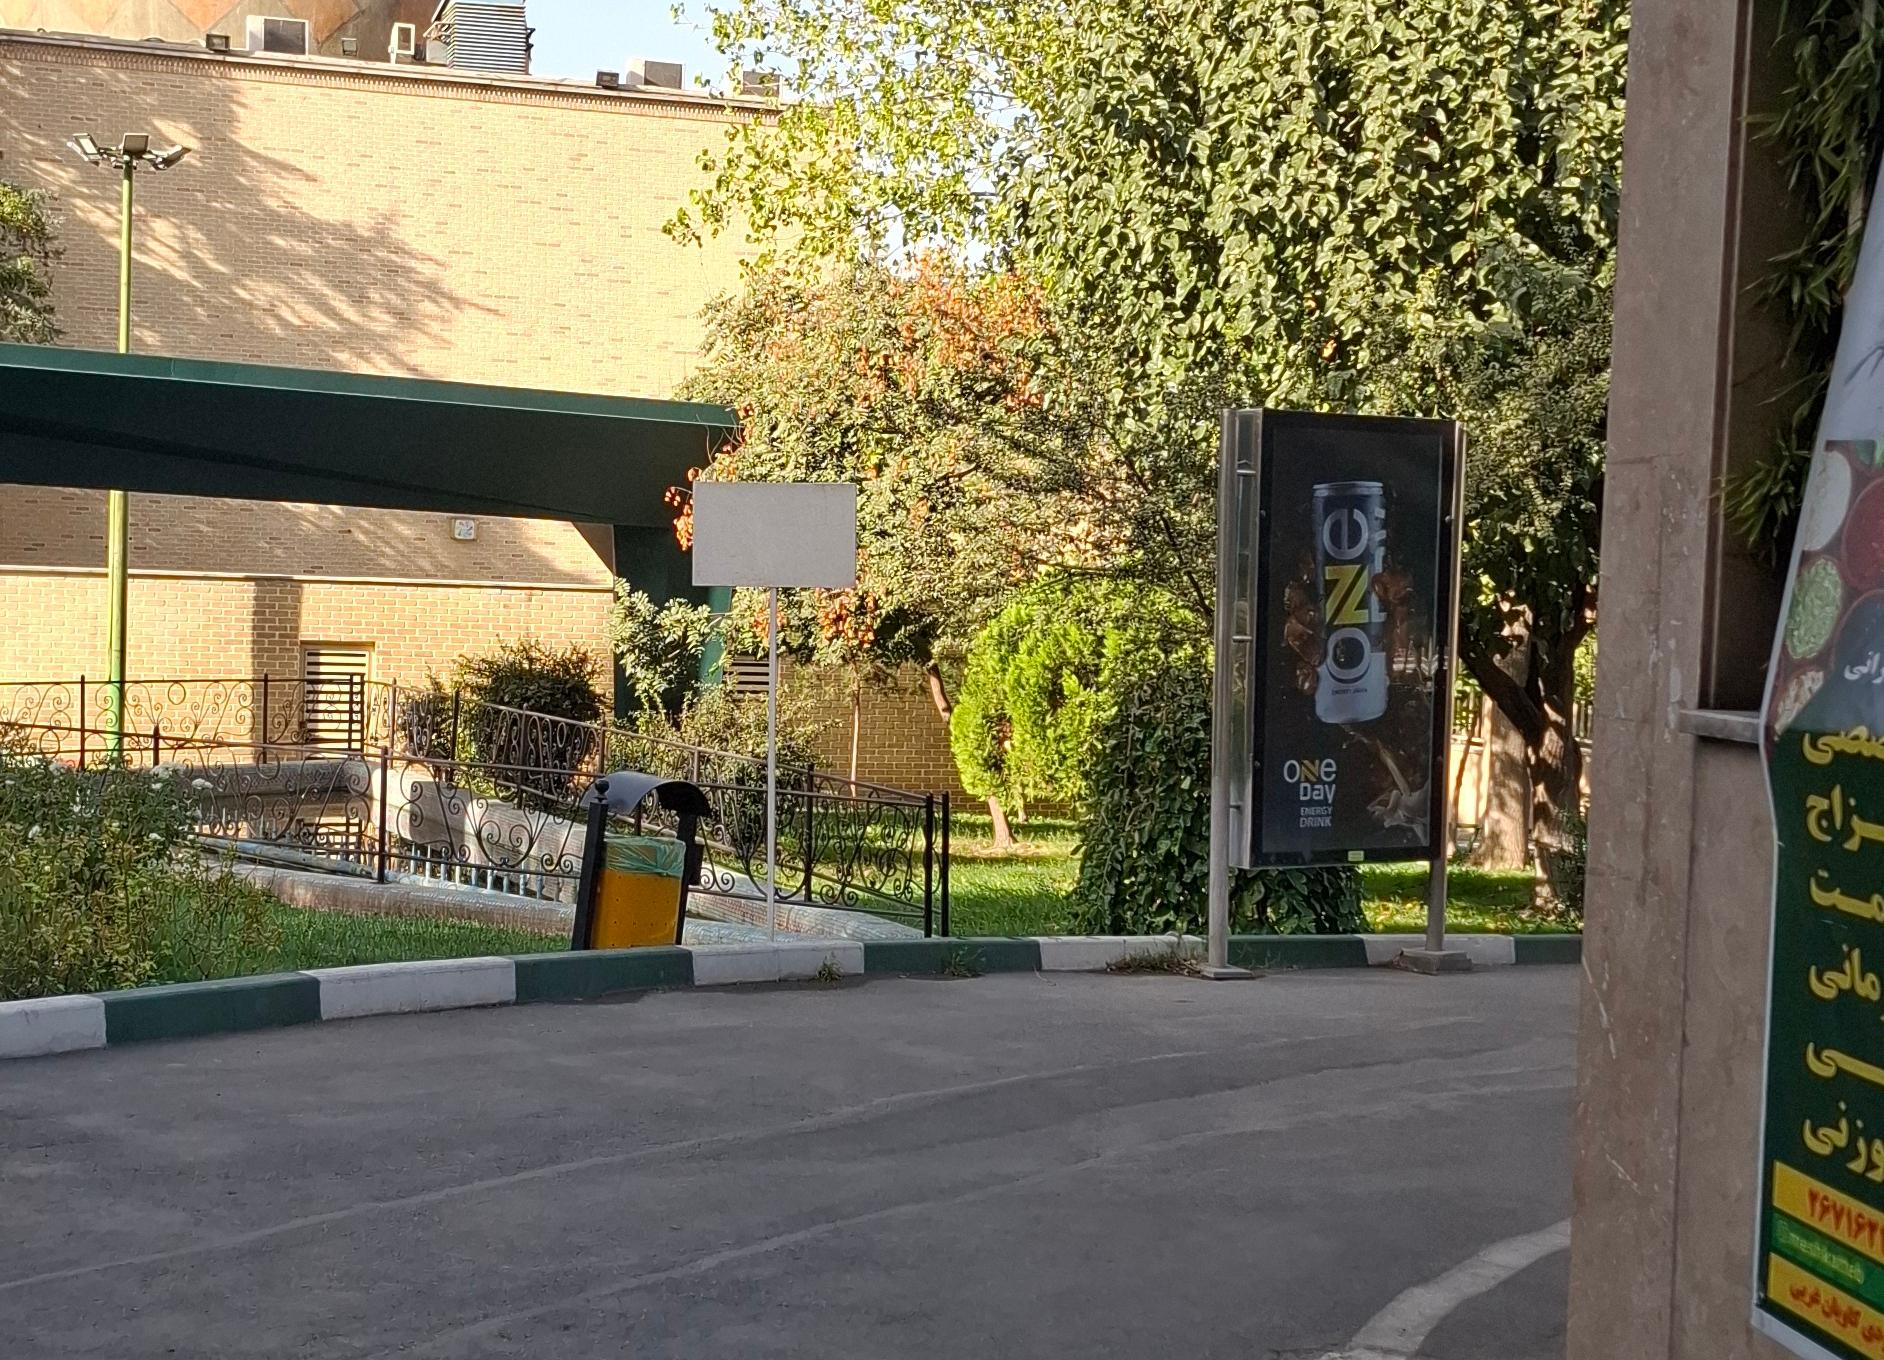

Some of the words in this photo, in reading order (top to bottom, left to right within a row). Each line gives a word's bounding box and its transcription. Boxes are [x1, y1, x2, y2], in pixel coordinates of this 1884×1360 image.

[1299, 782, 1336, 804] Day
[1300, 806, 1333, 816] ENERGY
[1299, 816, 1332, 828] DRINK
